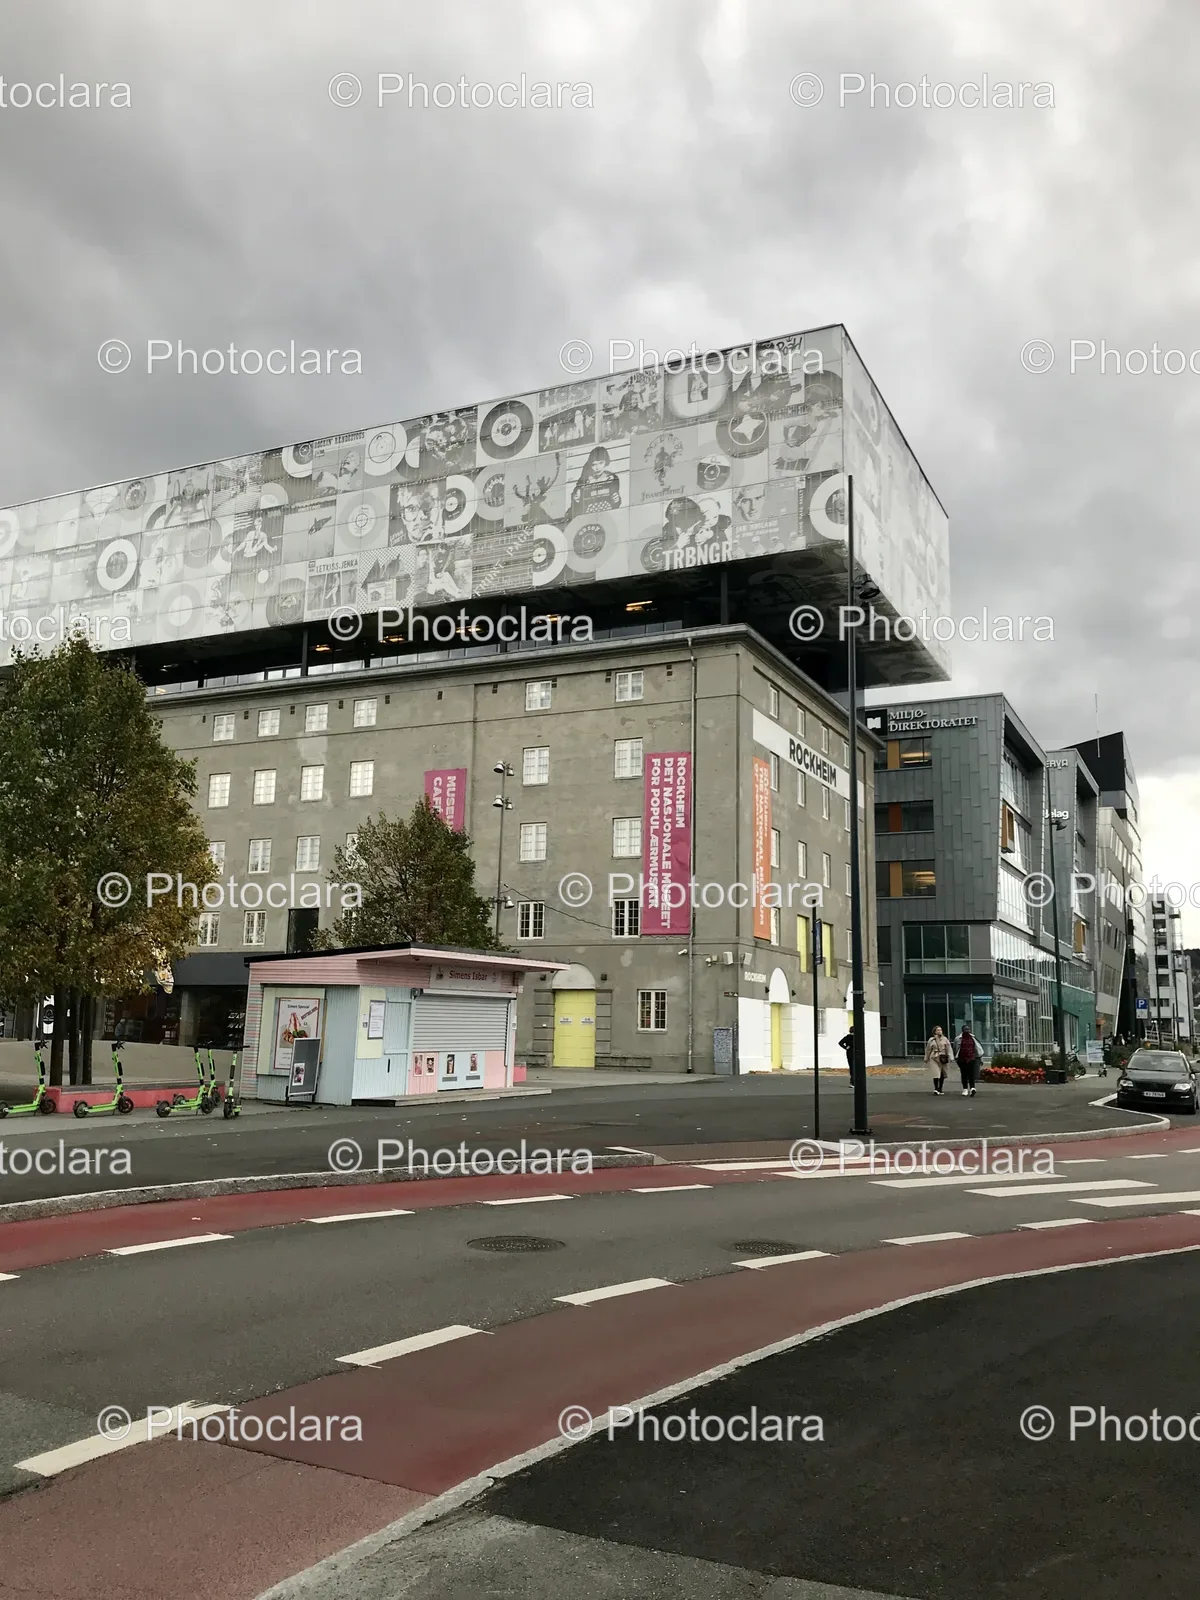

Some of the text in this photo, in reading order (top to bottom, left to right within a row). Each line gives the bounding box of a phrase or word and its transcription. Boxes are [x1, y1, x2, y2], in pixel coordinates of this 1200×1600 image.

[662, 541, 733, 571] TRBNGR
[889, 716, 978, 732] DIREKTORATET
[651, 758, 661, 786] FOR
[788, 737, 837, 788] ROCKHEIM
[675, 757, 687, 828] ROCKHEIM
[660, 758, 674, 929] DET NASJONALE MUSEET
[449, 970, 488, 981] Simens Isbar
